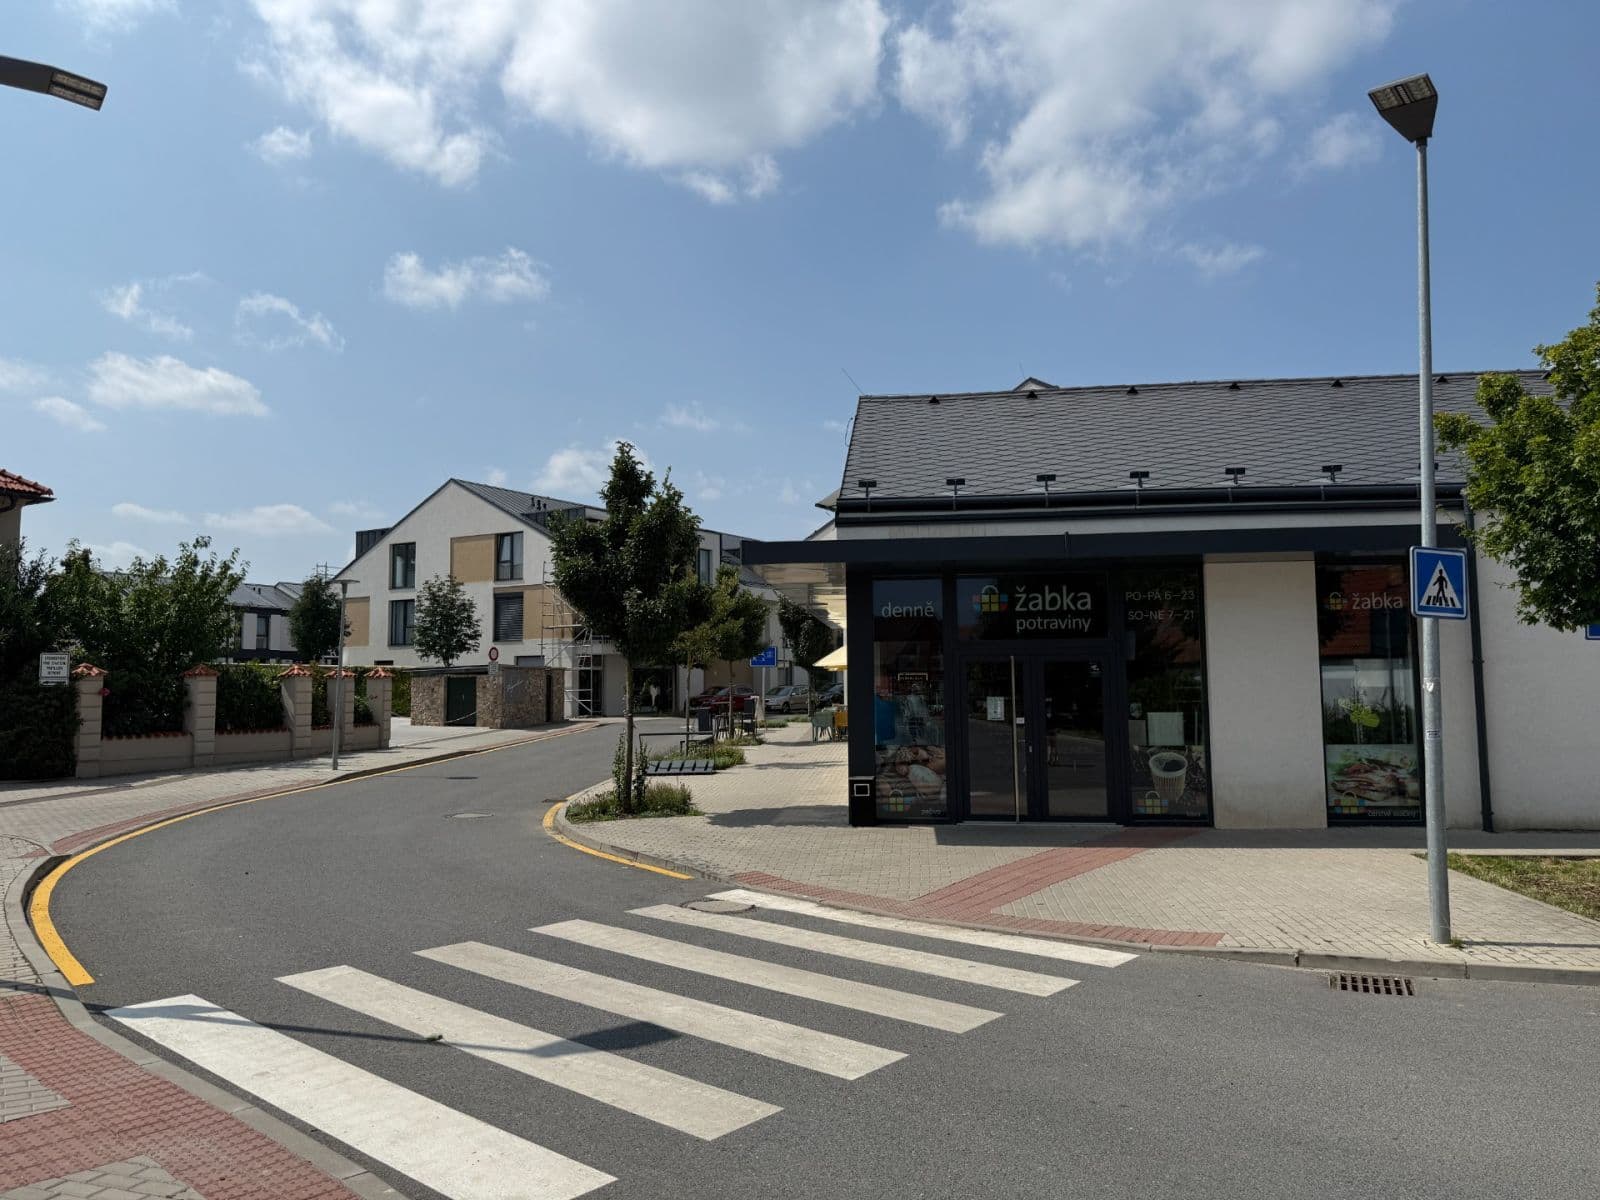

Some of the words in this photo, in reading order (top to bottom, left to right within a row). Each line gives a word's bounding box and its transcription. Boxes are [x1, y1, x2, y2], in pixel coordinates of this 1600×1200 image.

[1015, 585, 1092, 612] žabka
[1351, 591, 1404, 610] žabka
[881, 600, 935, 618] denně
[1016, 614, 1092, 633] potraviny
